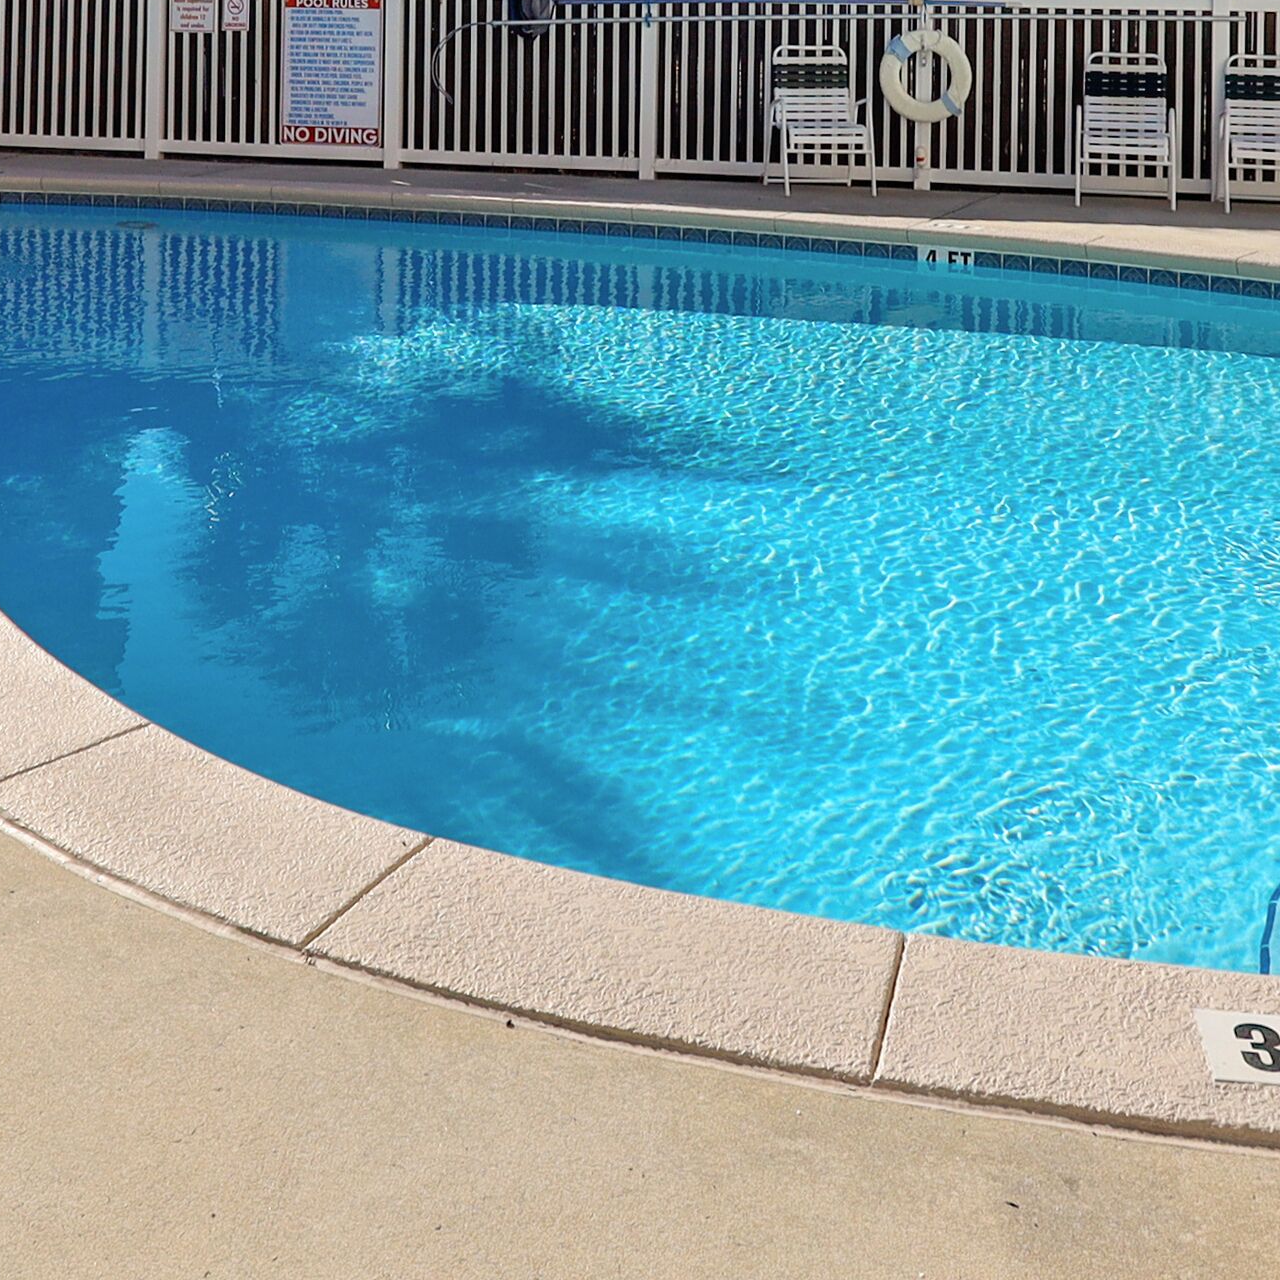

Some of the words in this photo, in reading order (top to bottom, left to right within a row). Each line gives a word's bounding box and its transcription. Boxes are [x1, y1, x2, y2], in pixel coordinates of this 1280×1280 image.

[283, 126, 310, 142] NO
[314, 128, 377, 144] DIVING
[926, 249, 937, 263] 4
[948, 251, 972, 266] FT
